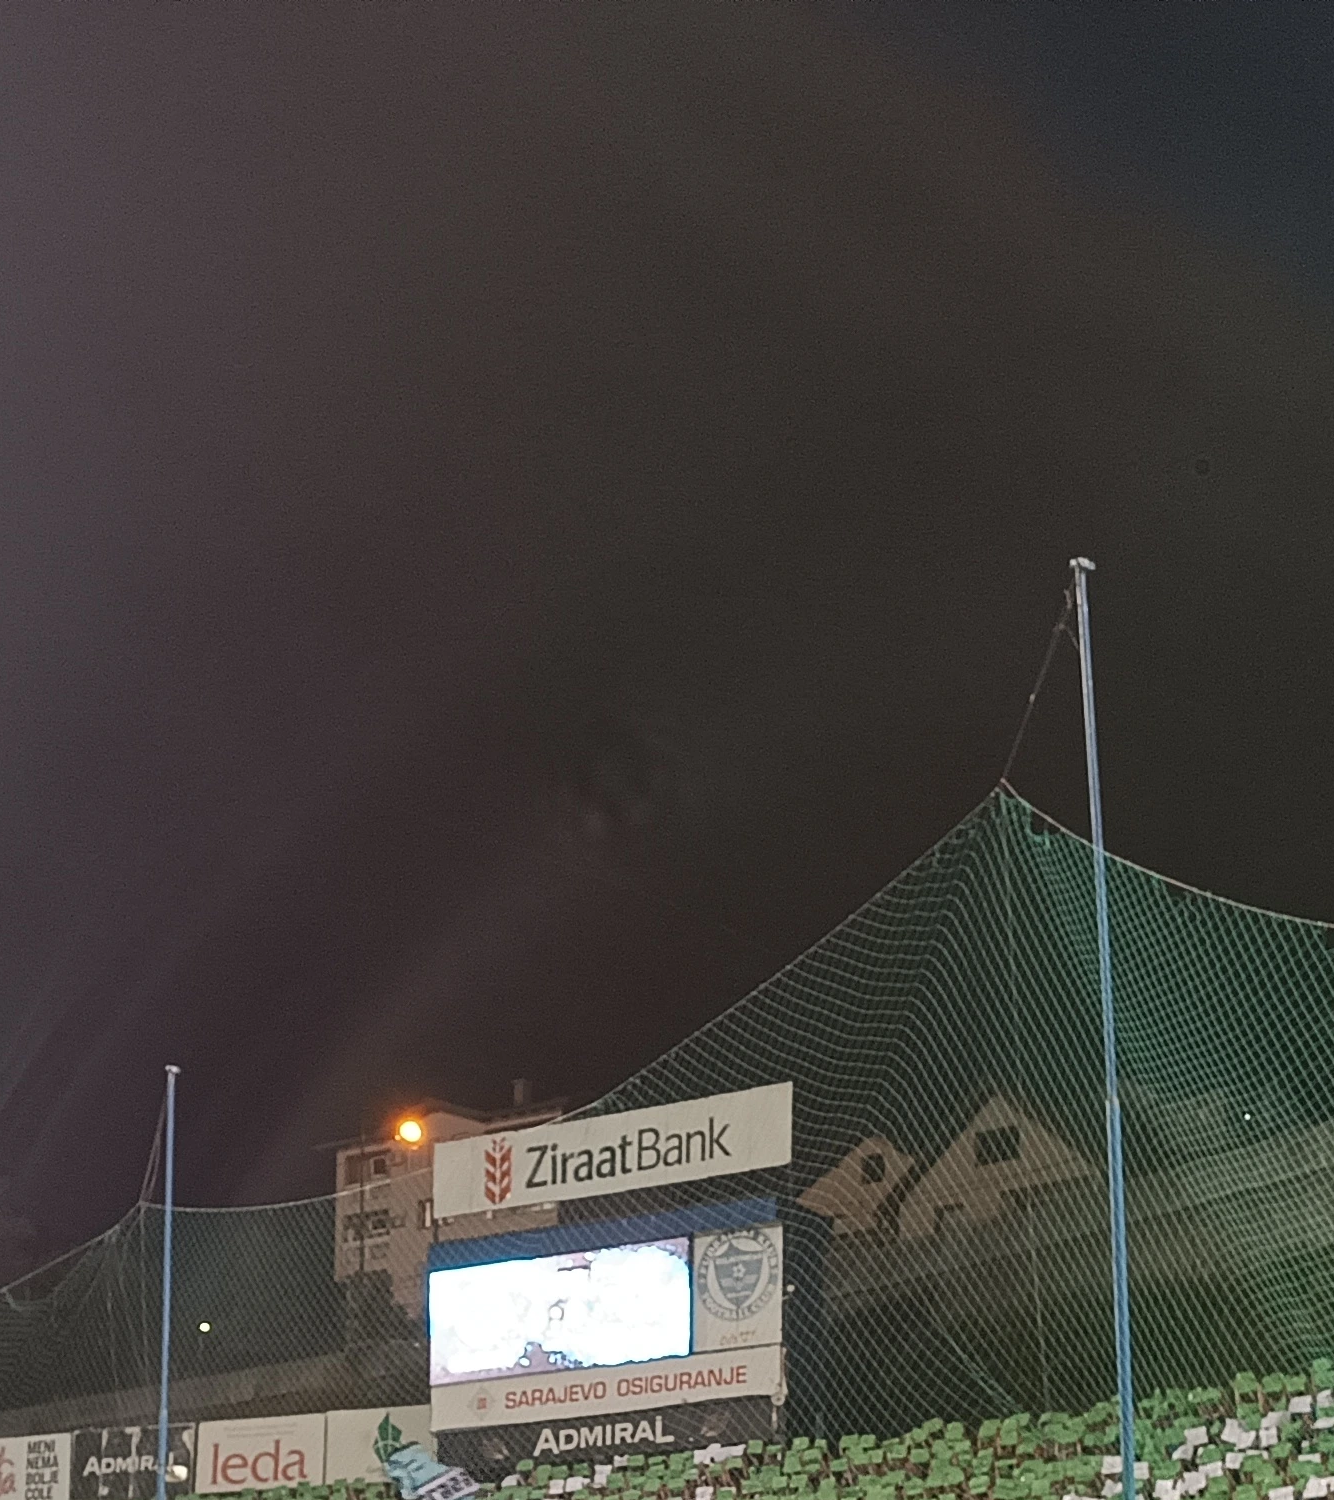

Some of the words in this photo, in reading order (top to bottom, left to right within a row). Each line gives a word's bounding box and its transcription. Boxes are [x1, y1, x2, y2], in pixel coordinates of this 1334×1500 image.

[525, 1117, 732, 1189] ZiraatBank
[504, 1381, 607, 1410] SARAJEVO
[616, 1365, 748, 1397] OSIGURANJE
[27, 1439, 56, 1454] MENI
[533, 1416, 675, 1456] ADMIRAL
[25, 1470, 59, 1486] BOLJE
[26, 1455, 59, 1470] NEMA
[82, 1451, 175, 1477] ADMIRL
[211, 1438, 308, 1486] leda
